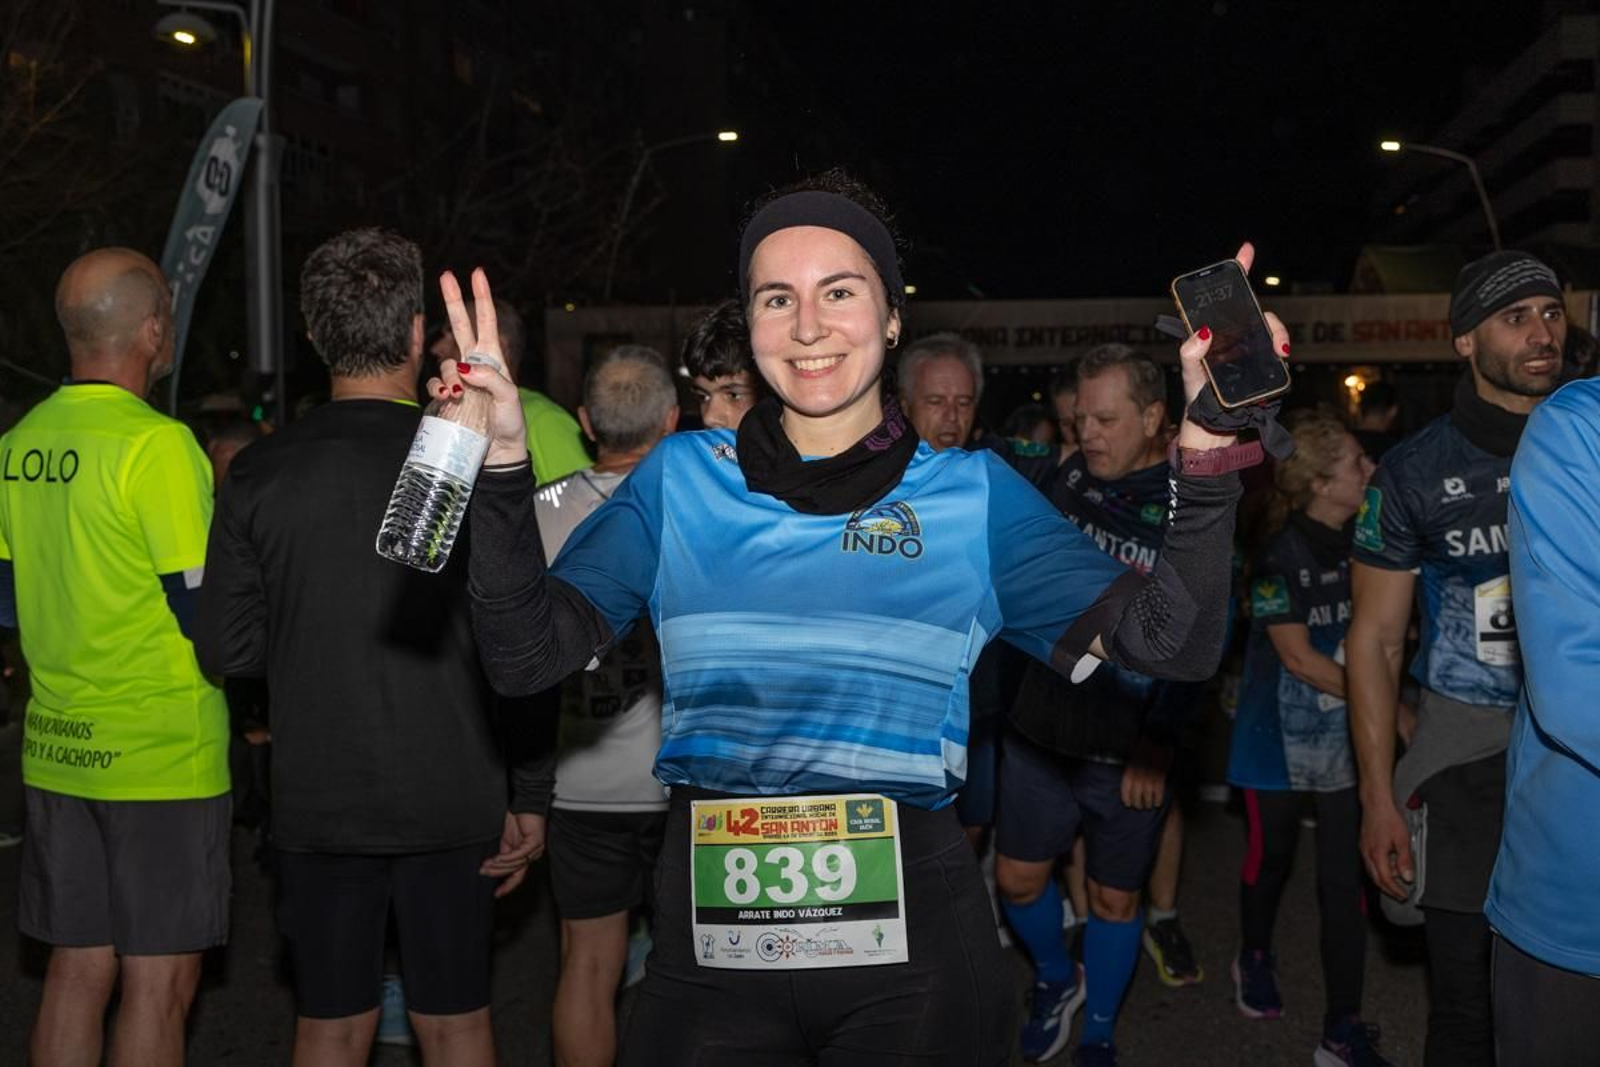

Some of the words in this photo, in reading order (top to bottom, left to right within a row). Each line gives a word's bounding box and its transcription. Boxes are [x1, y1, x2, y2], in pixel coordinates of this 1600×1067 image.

[1194, 284, 1234, 308] 21:37
[1313, 322, 1345, 342] DE
[1353, 320, 1399, 341] SAN
[1404, 320, 1451, 341] ANT
[3, 448, 79, 483] LOLO
[841, 531, 924, 560] INDO
[1082, 521, 1157, 568] ANTÓN
[1307, 604, 1333, 627] AN
[1490, 599, 1515, 629] 8
[726, 808, 759, 836] 42
[760, 805, 799, 815] CARRERA
[761, 820, 788, 836] SAN
[724, 845, 857, 905] 839
[738, 909, 771, 920] ARRATE
[773, 908, 795, 919] INDO
[799, 907, 843, 918] VÁZQUEZ
